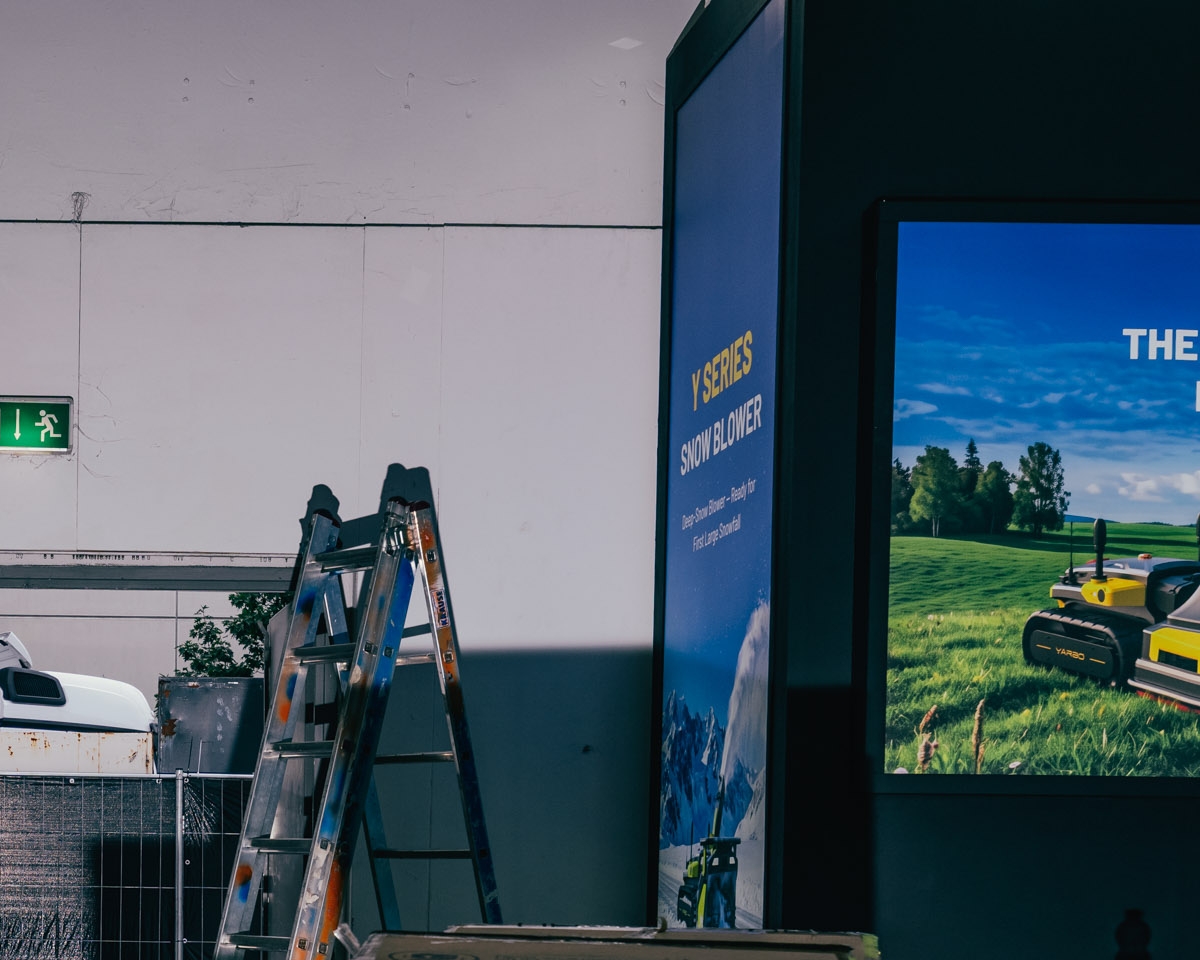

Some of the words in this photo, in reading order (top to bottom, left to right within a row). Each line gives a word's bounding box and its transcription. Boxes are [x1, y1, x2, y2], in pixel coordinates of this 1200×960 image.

[1122, 328, 1199, 361] THE
[692, 369, 701, 412] Y
[703, 330, 753, 404] SERIES
[680, 426, 712, 476] SNOW
[713, 393, 762, 456] BLOWER
[681, 505, 708, 530] Deep-Snow
[709, 495, 726, 515] Blower
[731, 481, 747, 504] Ready
[705, 523, 719, 547] Large
[719, 513, 742, 538] Snowfall
[1054, 645, 1086, 661] YARBO
